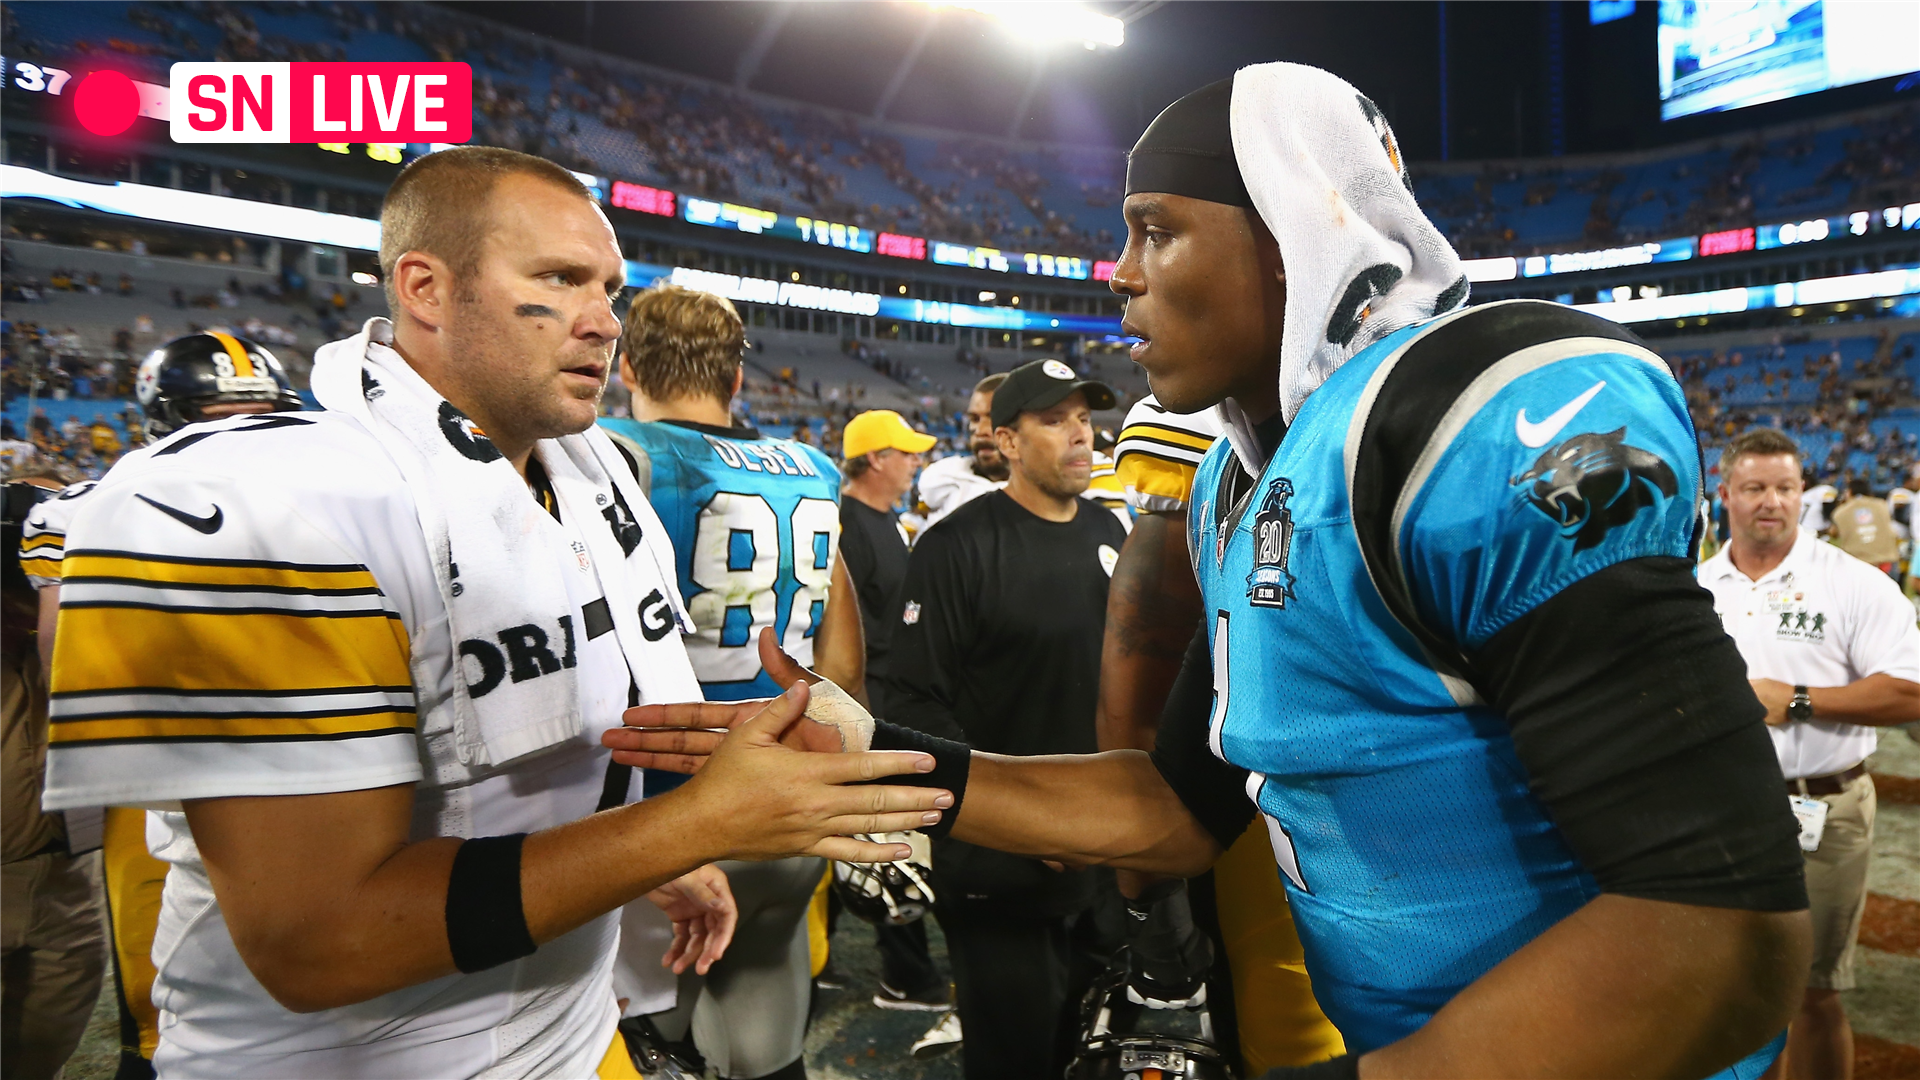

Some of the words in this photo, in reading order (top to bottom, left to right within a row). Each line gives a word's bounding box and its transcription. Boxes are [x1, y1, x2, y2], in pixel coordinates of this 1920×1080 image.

[15, 62, 72, 96] 37
[701, 434, 816, 478] OLSEN
[1258, 520, 1283, 564] 20
[684, 491, 841, 684] 88
[638, 588, 676, 642] G
